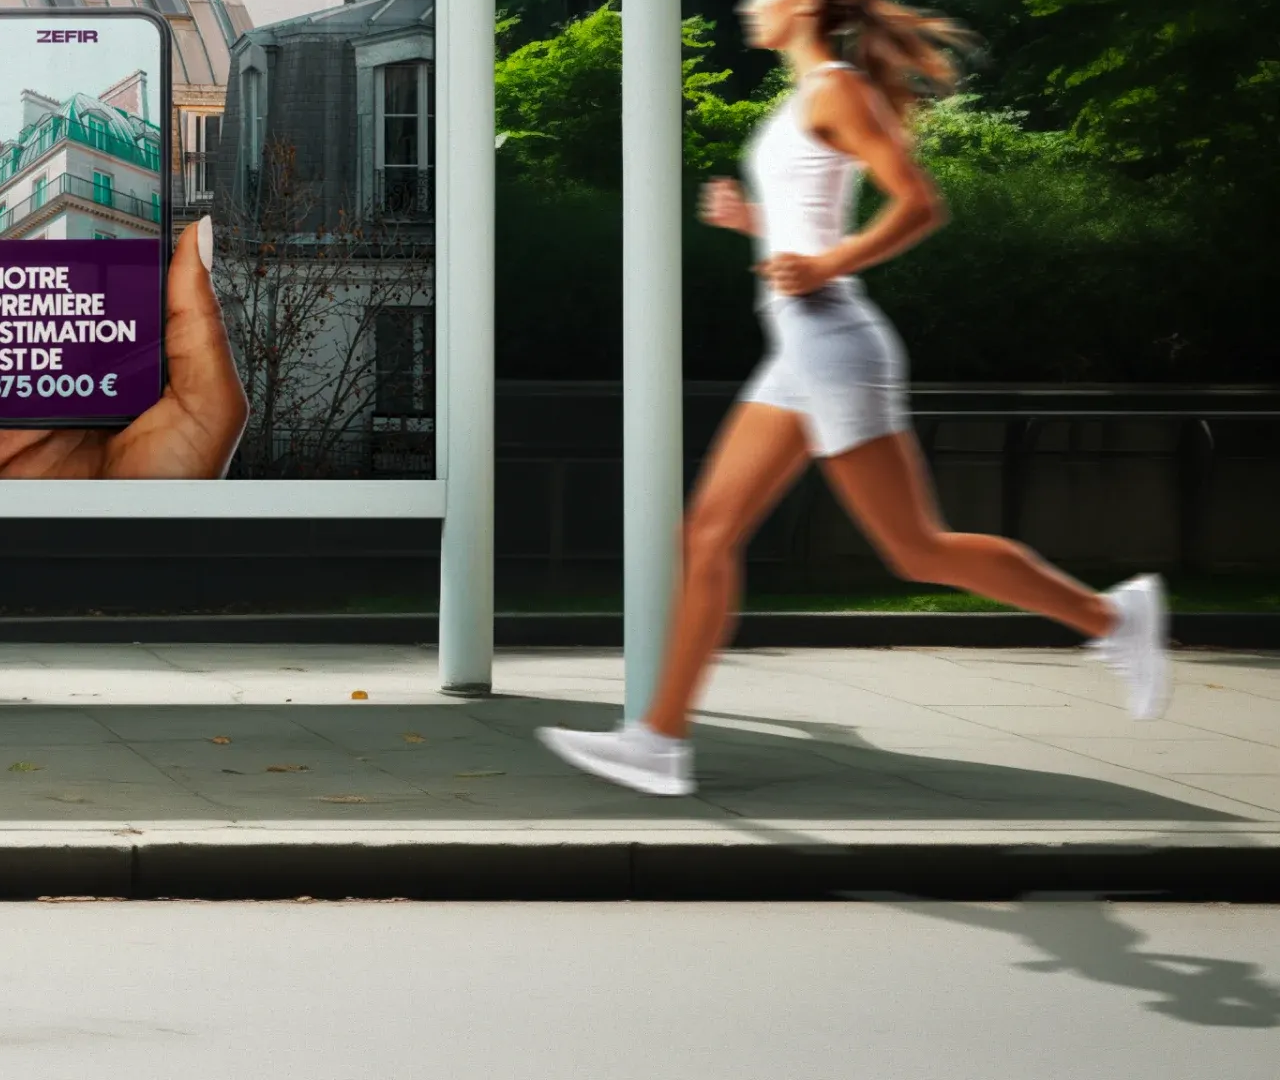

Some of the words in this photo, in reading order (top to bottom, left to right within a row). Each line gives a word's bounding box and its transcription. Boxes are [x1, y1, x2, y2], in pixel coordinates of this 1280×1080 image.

[37, 30, 98, 43] ZEFIR
[31, 348, 62, 370] DE
[37, 374, 94, 397] 000
[100, 373, 117, 396] €
